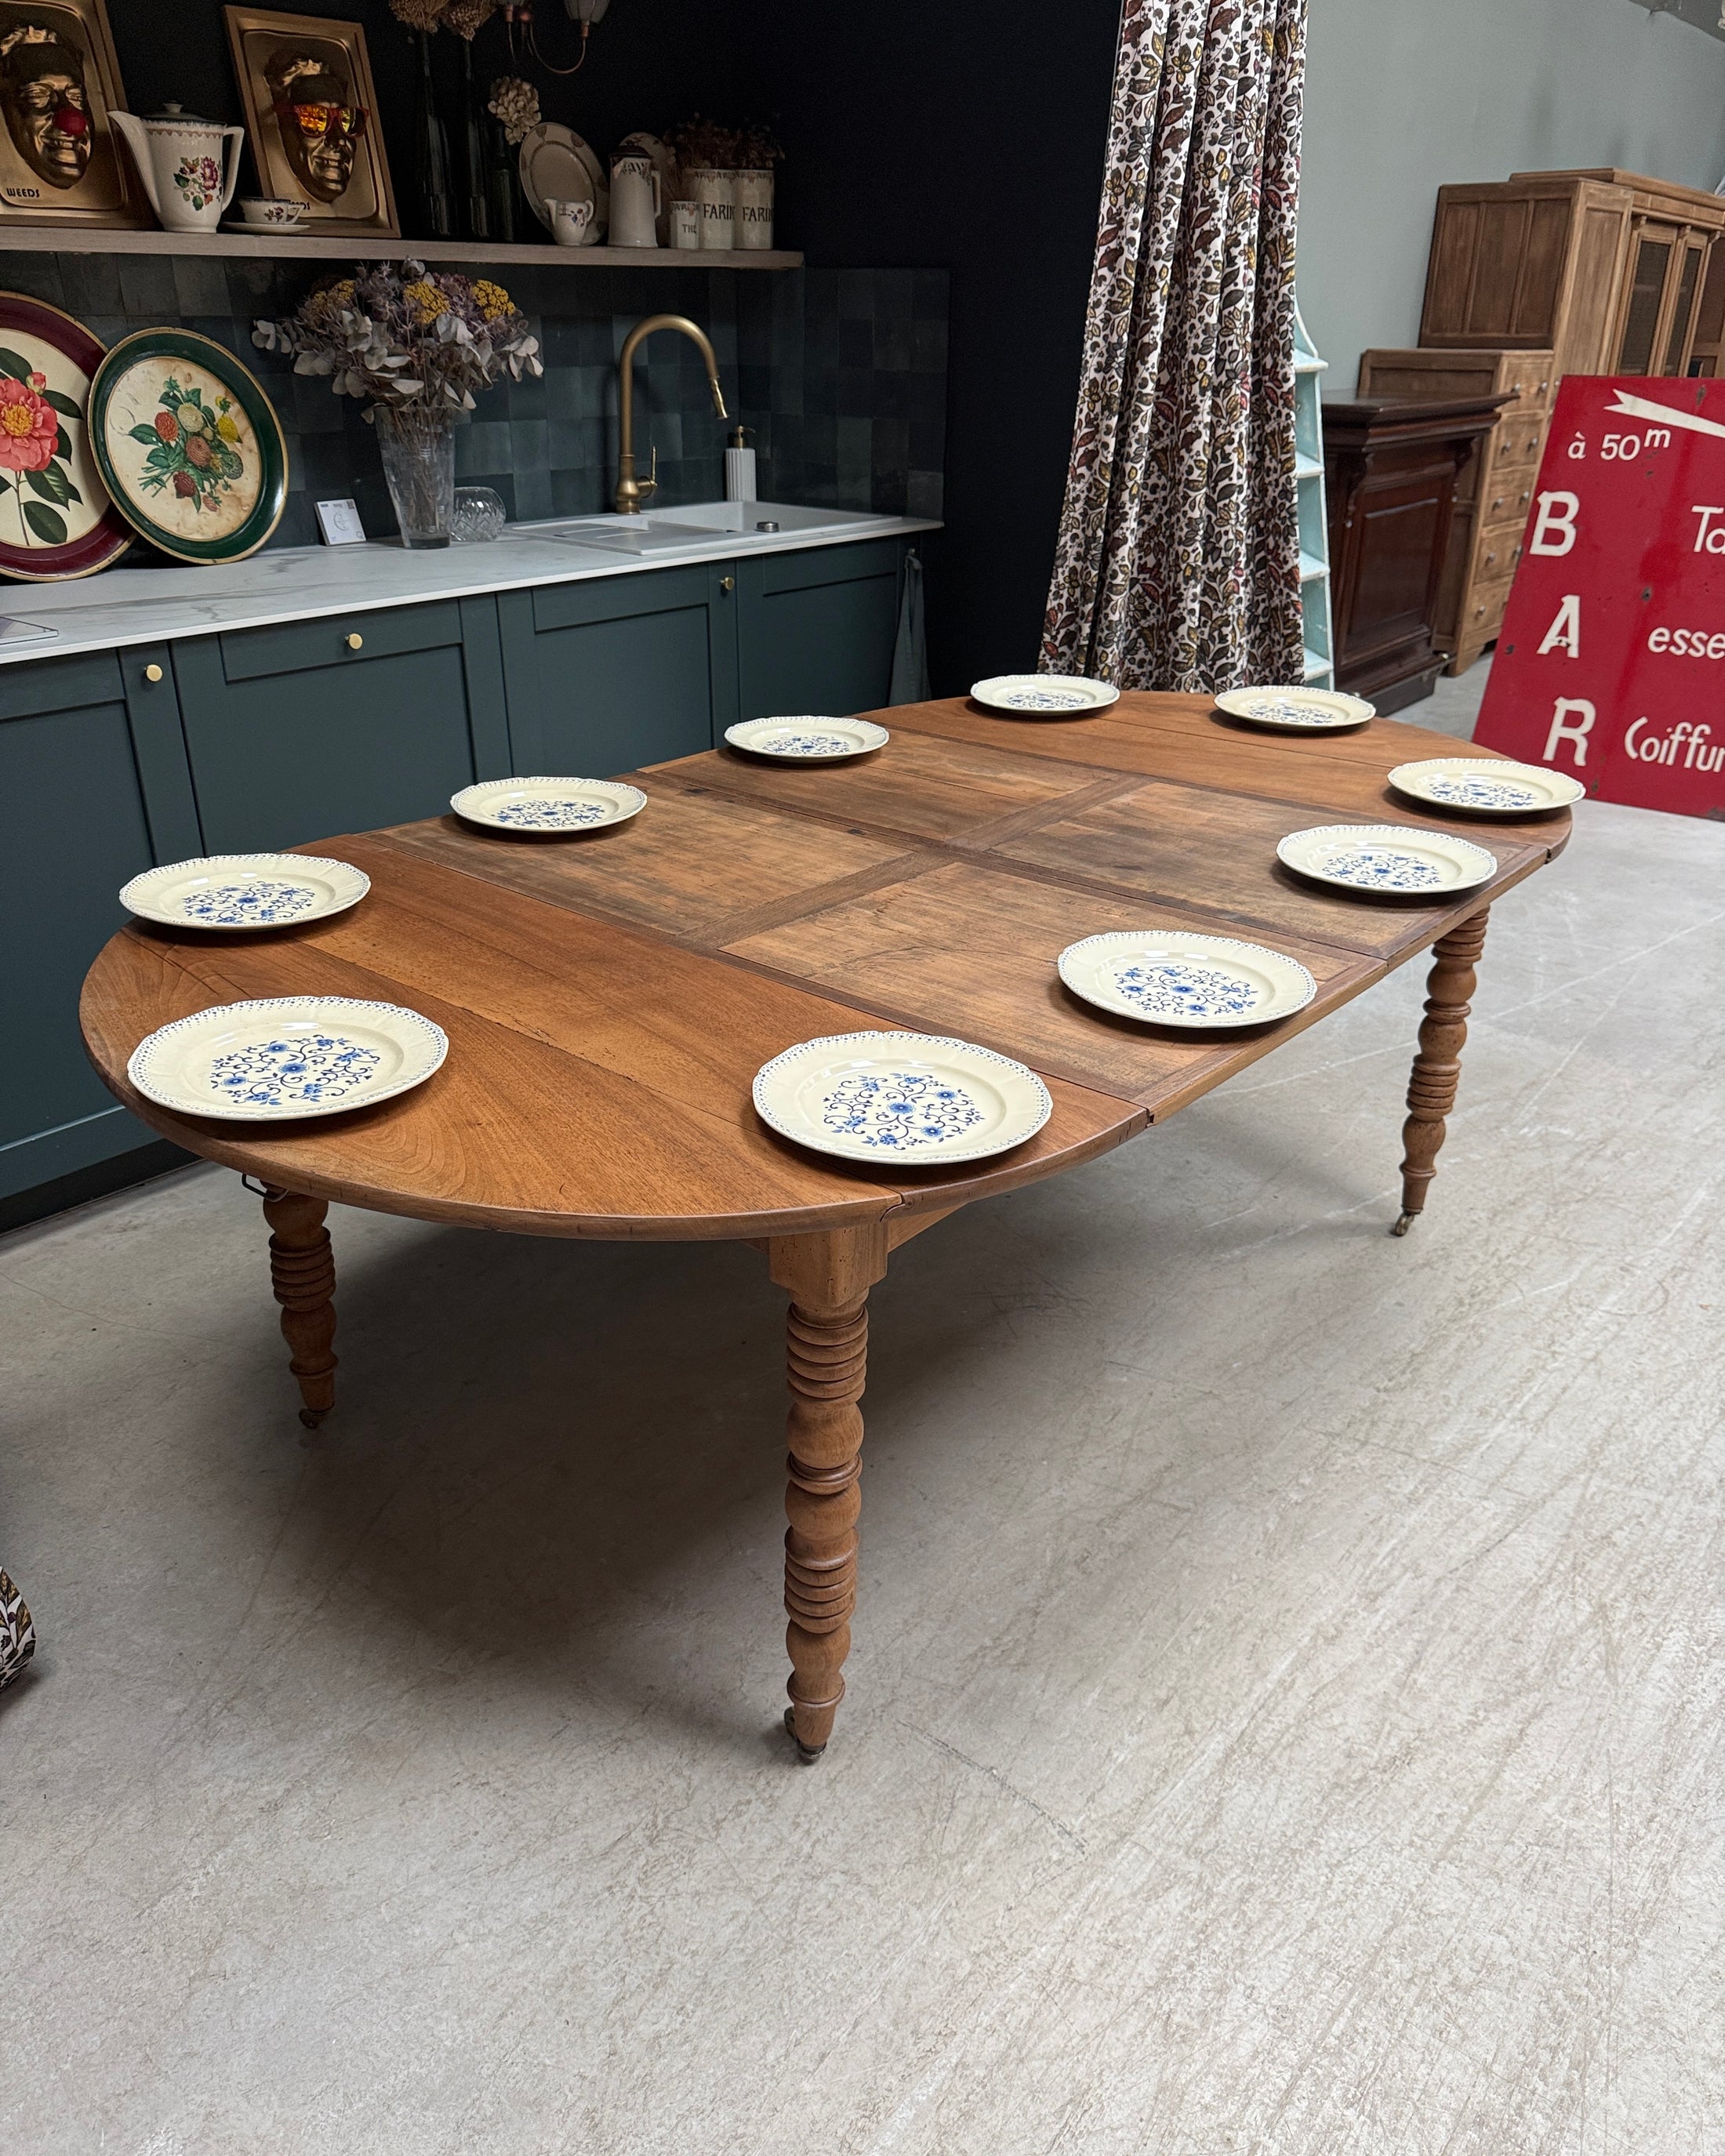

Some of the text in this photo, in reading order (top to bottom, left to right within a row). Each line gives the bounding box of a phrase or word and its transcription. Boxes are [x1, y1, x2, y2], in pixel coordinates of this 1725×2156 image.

[6, 187, 40, 198] WEEDS
[1567, 430, 1586, 459] à
[1647, 626, 1725, 660] esse
[1624, 716, 1725, 773] Coiffur
